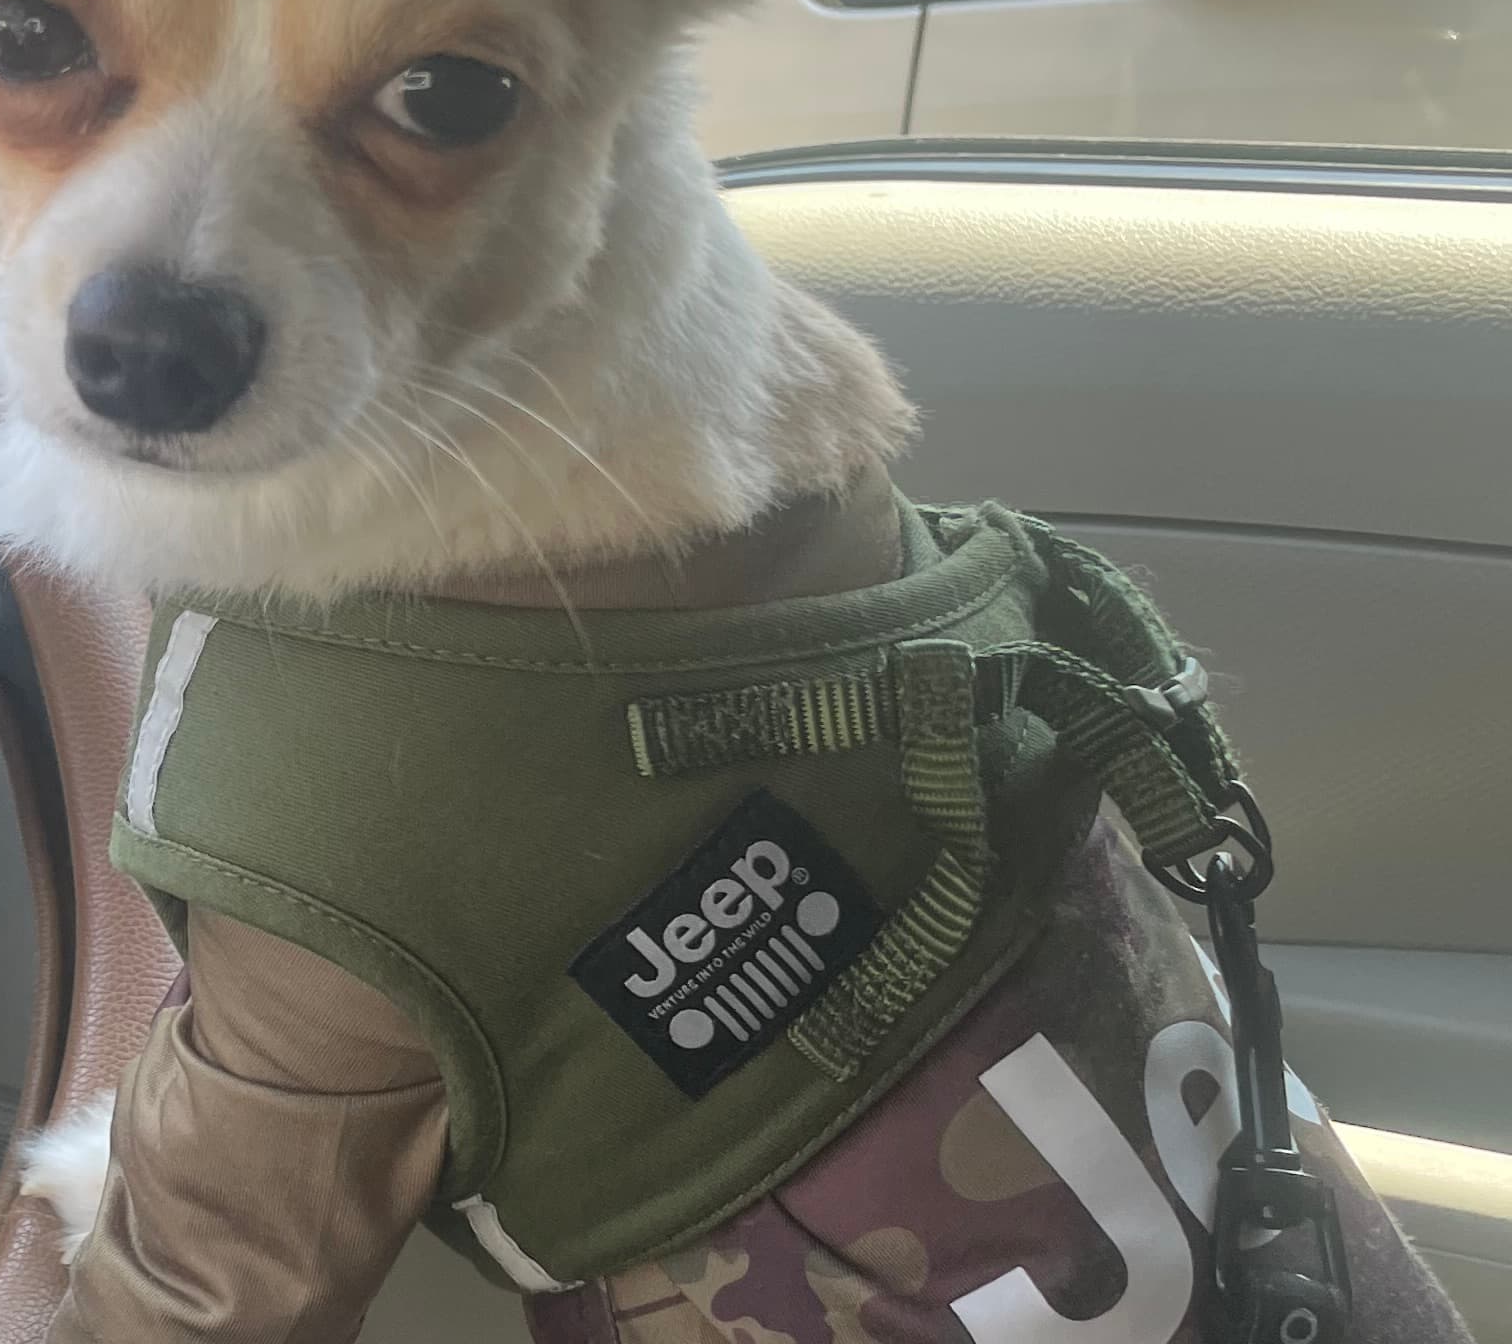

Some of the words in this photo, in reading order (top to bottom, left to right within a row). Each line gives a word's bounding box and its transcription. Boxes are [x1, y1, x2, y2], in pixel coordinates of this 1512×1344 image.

[648, 978, 700, 1020] VENTURE
[695, 957, 724, 984] INTO
[721, 936, 747, 959] THE
[740, 912, 772, 939] WILD
